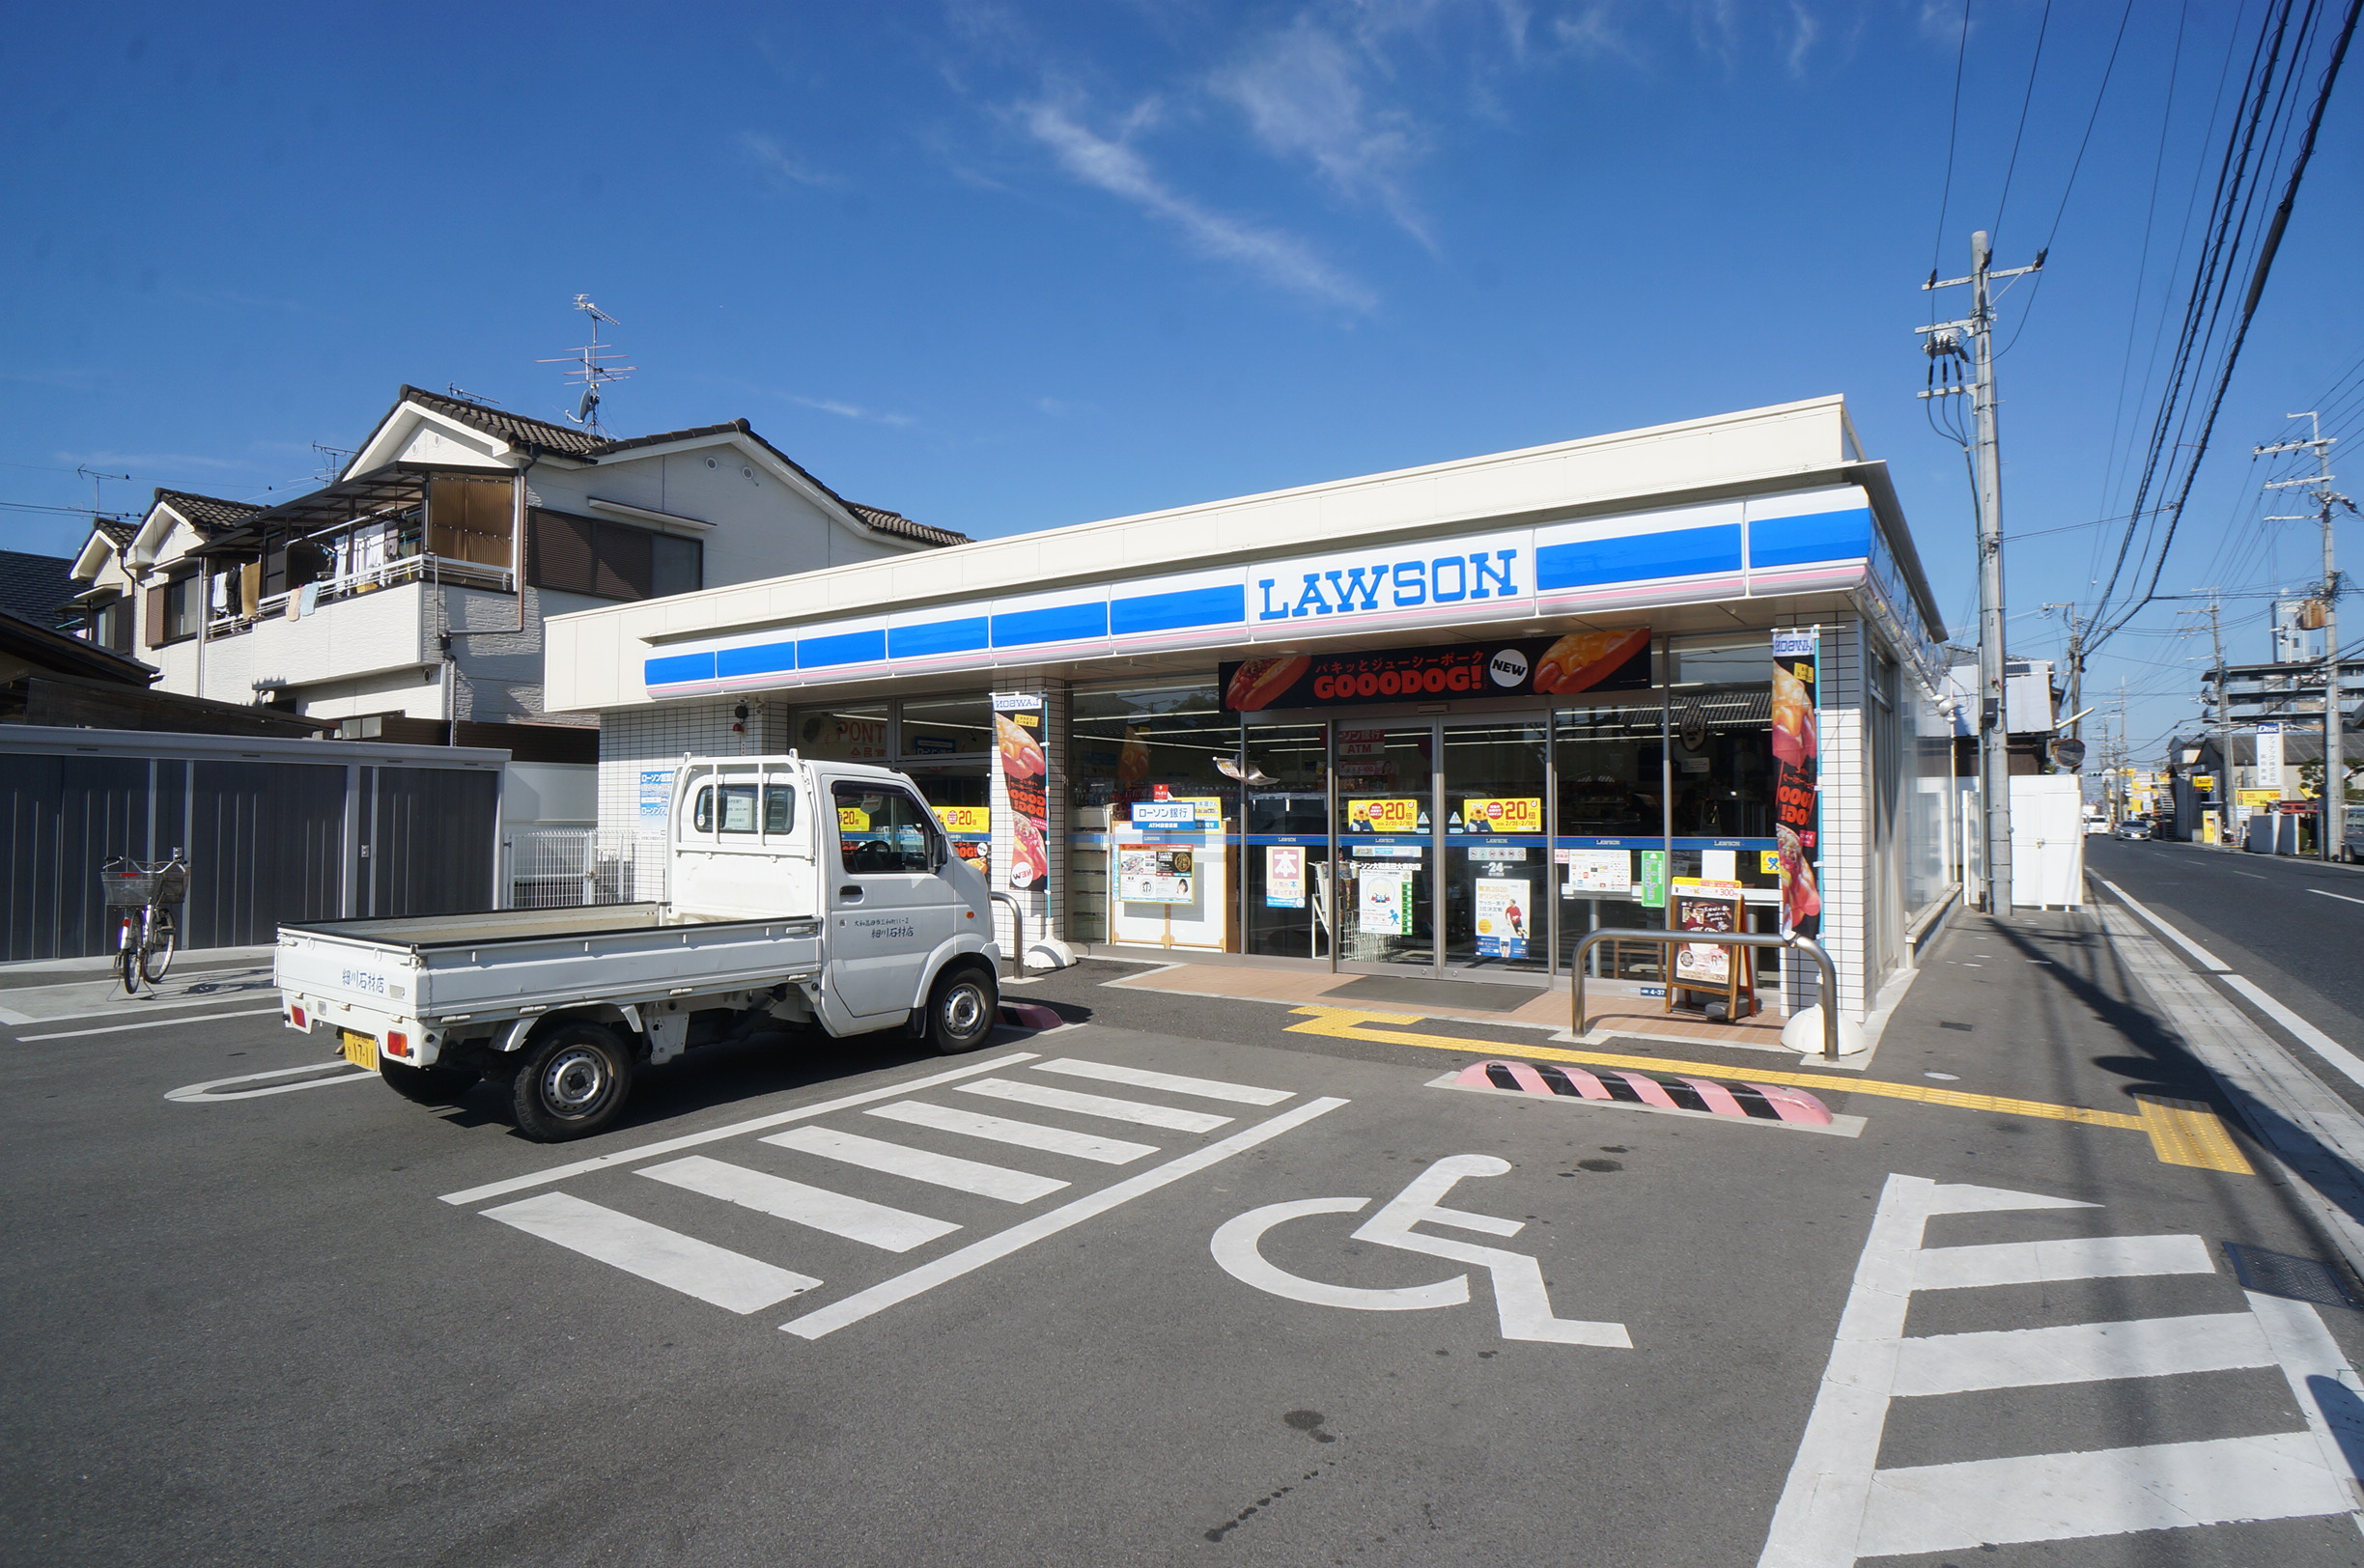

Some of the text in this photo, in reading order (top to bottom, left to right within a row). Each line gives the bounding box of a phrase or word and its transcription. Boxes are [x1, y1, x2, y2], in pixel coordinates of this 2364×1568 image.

[1258, 548, 1518, 620] LAWSON
[1314, 651, 1484, 674] パキッとジューシーポーク
[1491, 658, 1526, 678] NEW
[1313, 665, 1482, 699] GOOODOG!
[1347, 744, 1371, 753] ATM
[1139, 808, 1188, 819] ローソン銀行
[1274, 850, 1297, 878] 本
[1488, 861, 1505, 873] 24
[871, 926, 915, 938] 細川石材店
[342, 968, 384, 994] 細川石材店
[353, 1043, 374, 1067] 17-11
